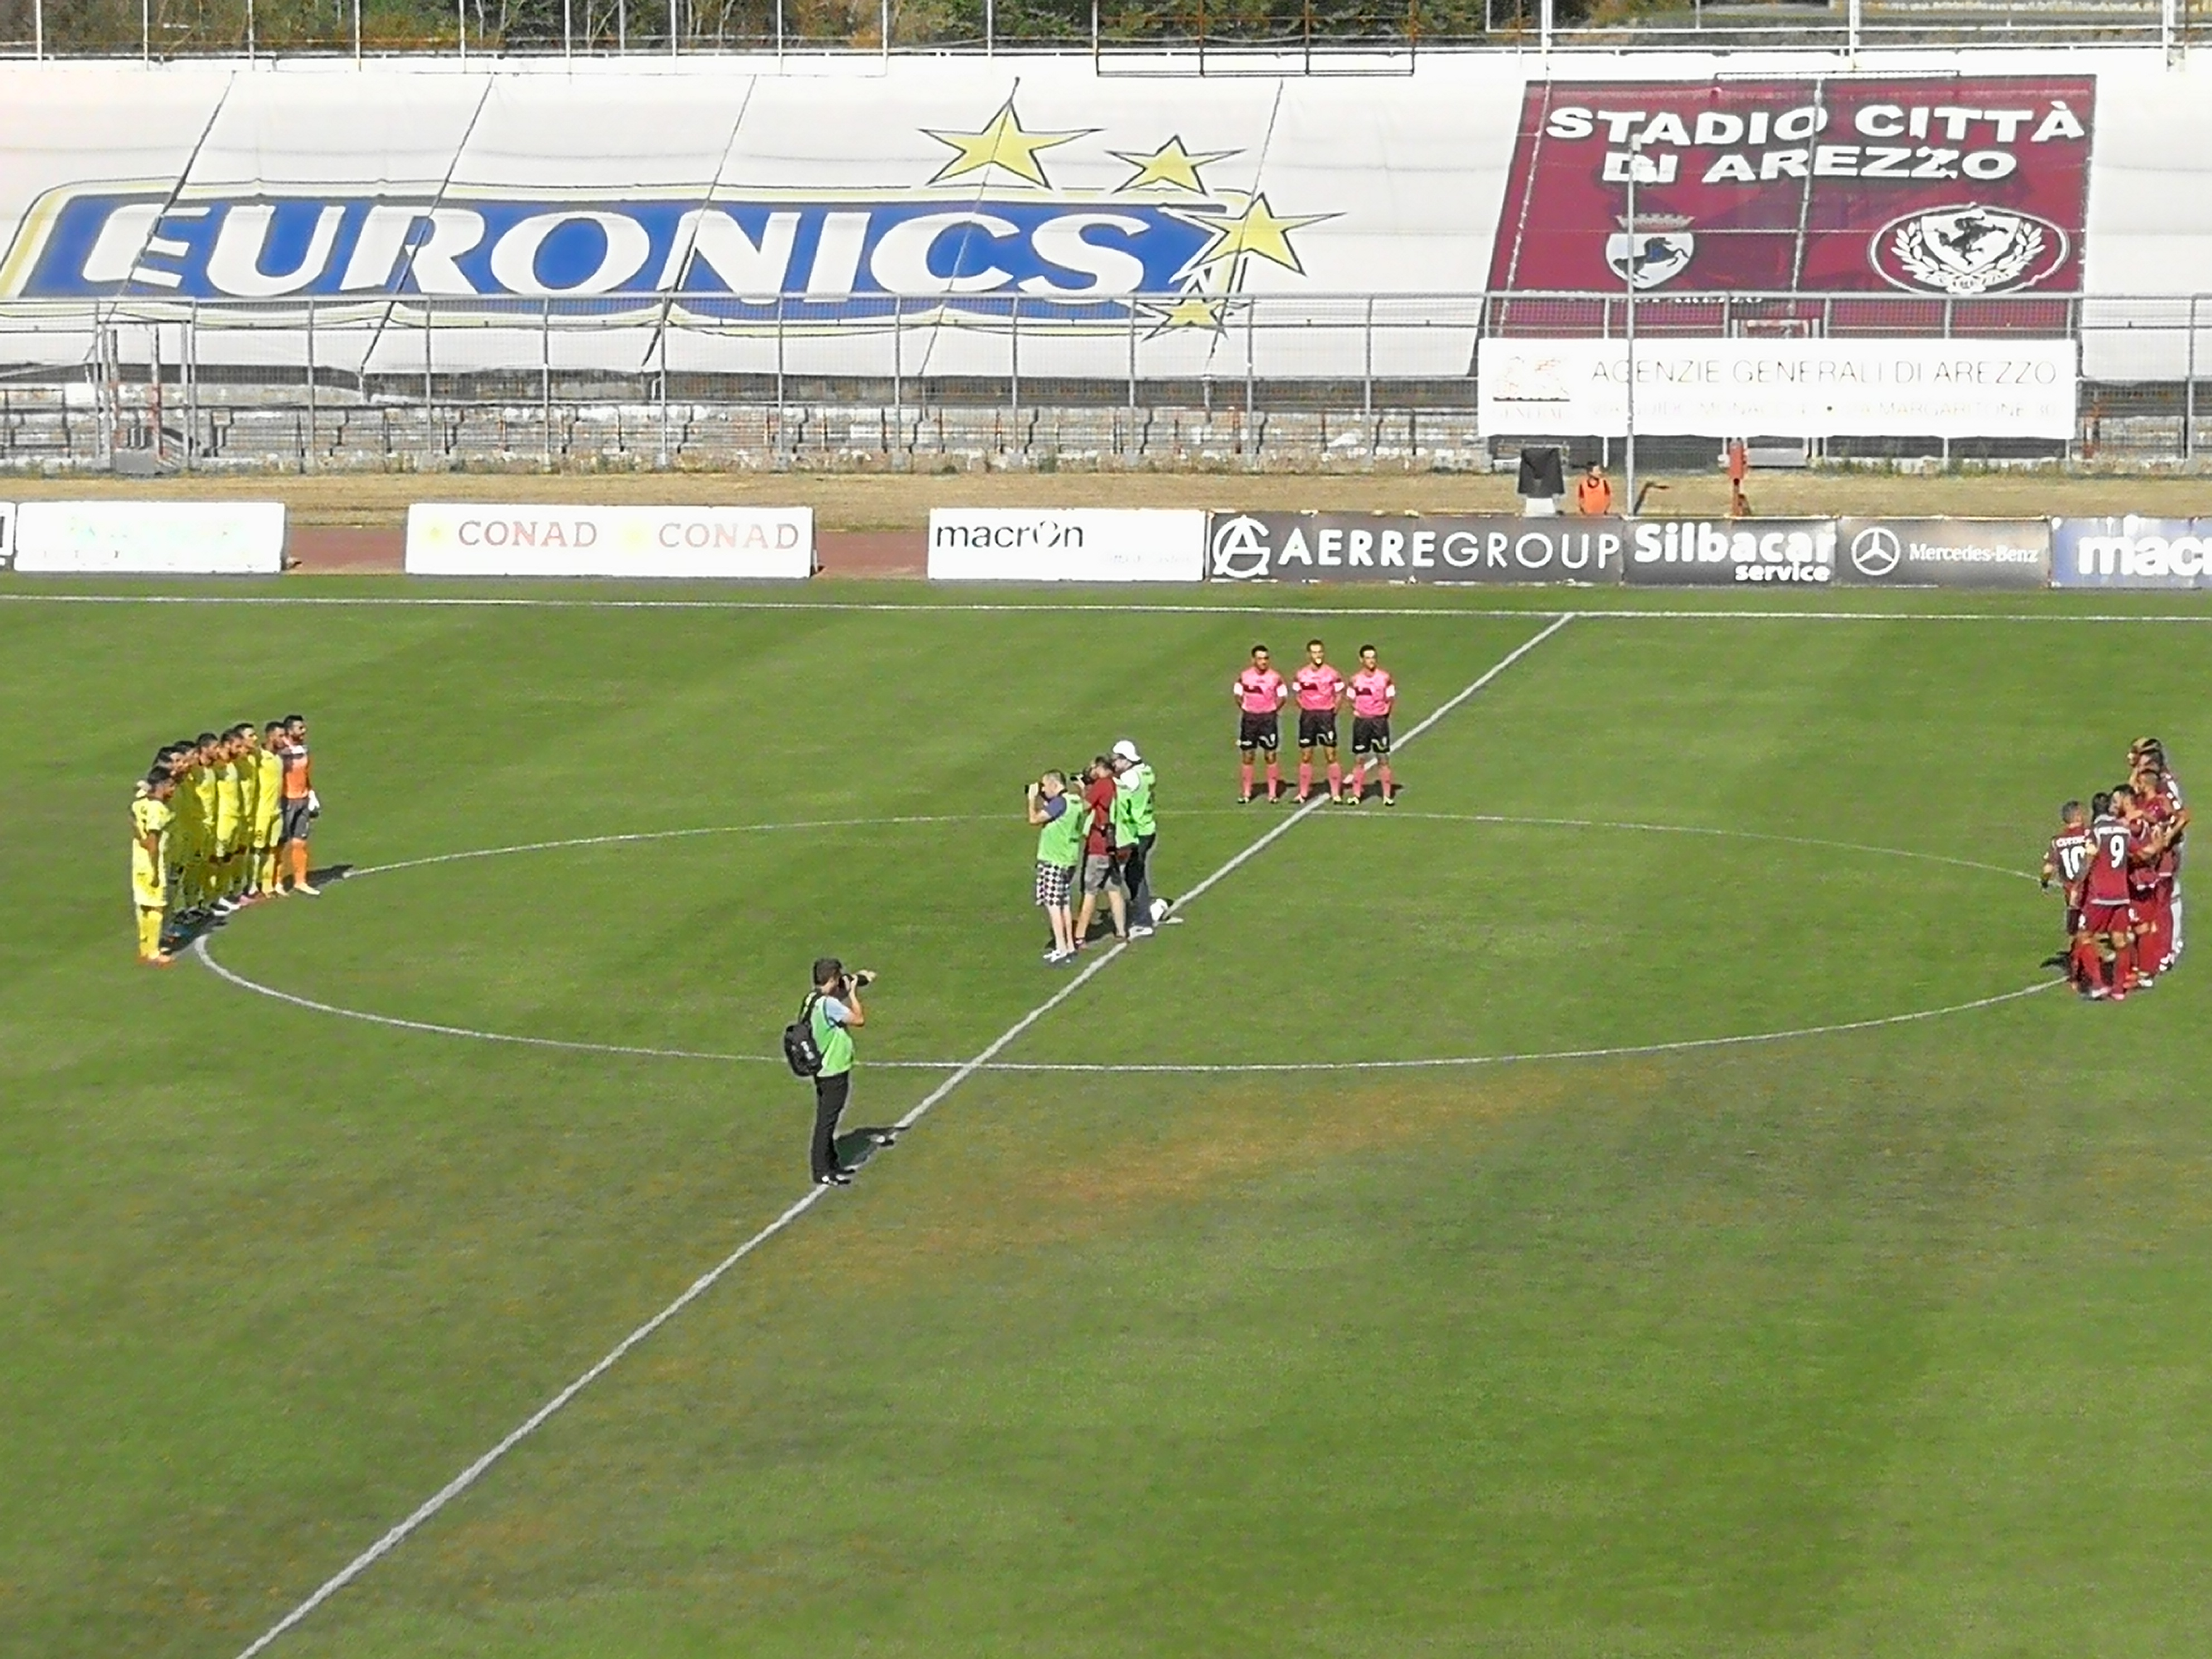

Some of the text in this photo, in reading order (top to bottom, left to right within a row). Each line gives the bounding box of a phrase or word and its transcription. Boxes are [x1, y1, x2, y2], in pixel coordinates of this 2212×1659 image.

[1546, 100, 2085, 146] STADIO CITTÀ
[1602, 145, 2017, 183] DI AREZZO
[83, 204, 1151, 304] EURONICS
[1592, 360, 2056, 384] AGENZIE GENERALI DI AREZZO
[458, 521, 798, 549] CONAD CONAD
[936, 520, 1084, 548] macron
[1278, 527, 1620, 569] AERREGROUP
[1634, 522, 1836, 563] Silbacar
[1909, 543, 2038, 562] Mercedes-Benz
[1735, 563, 1831, 581] service
[2110, 835, 2124, 868] 9
